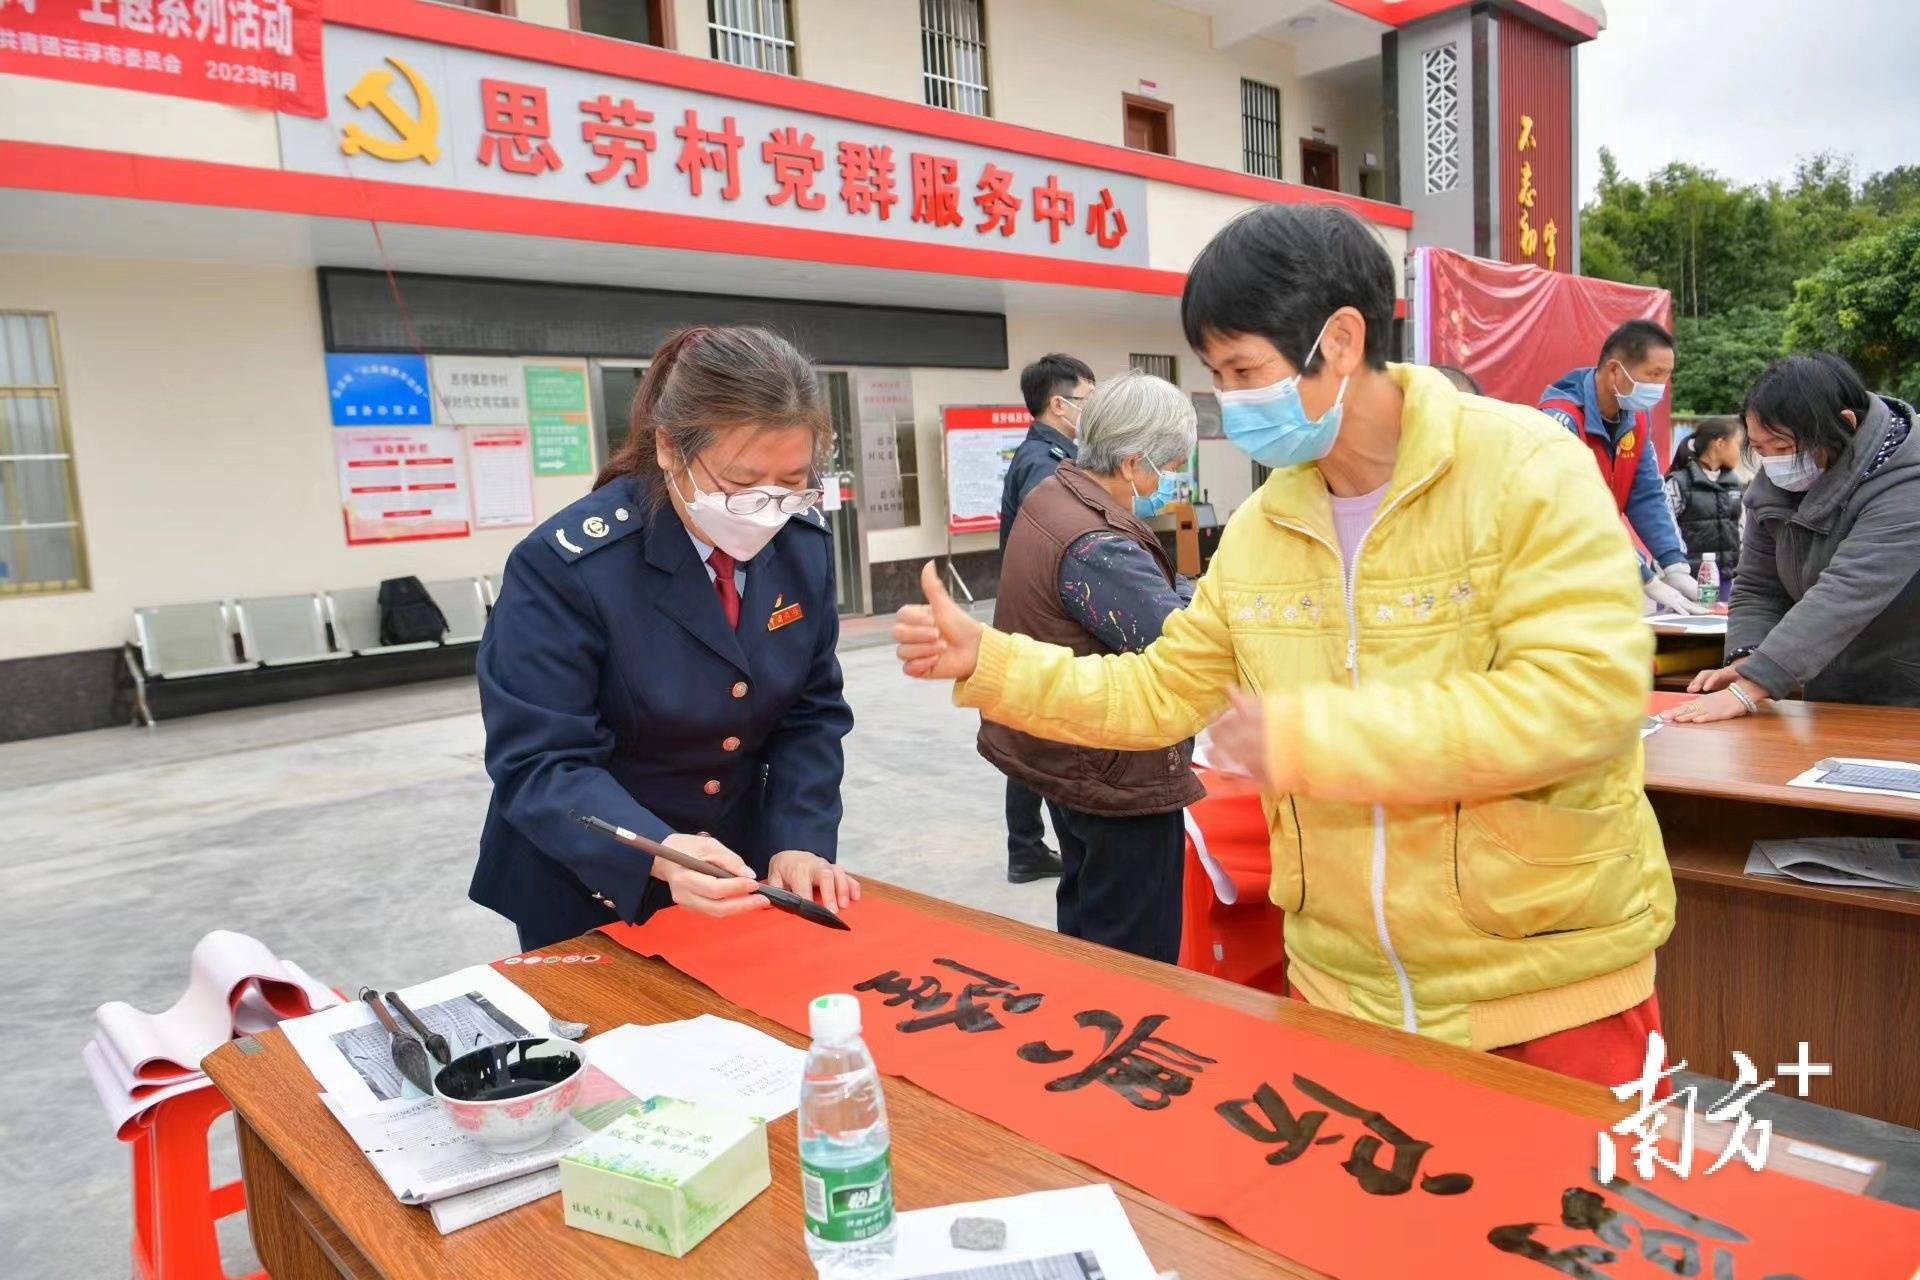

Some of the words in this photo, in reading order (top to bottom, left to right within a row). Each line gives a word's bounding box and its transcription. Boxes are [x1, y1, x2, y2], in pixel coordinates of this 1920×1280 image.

[206, 60, 297, 92] 2023年1月
[478, 78, 1129, 250] 思劳村党群服务中心
